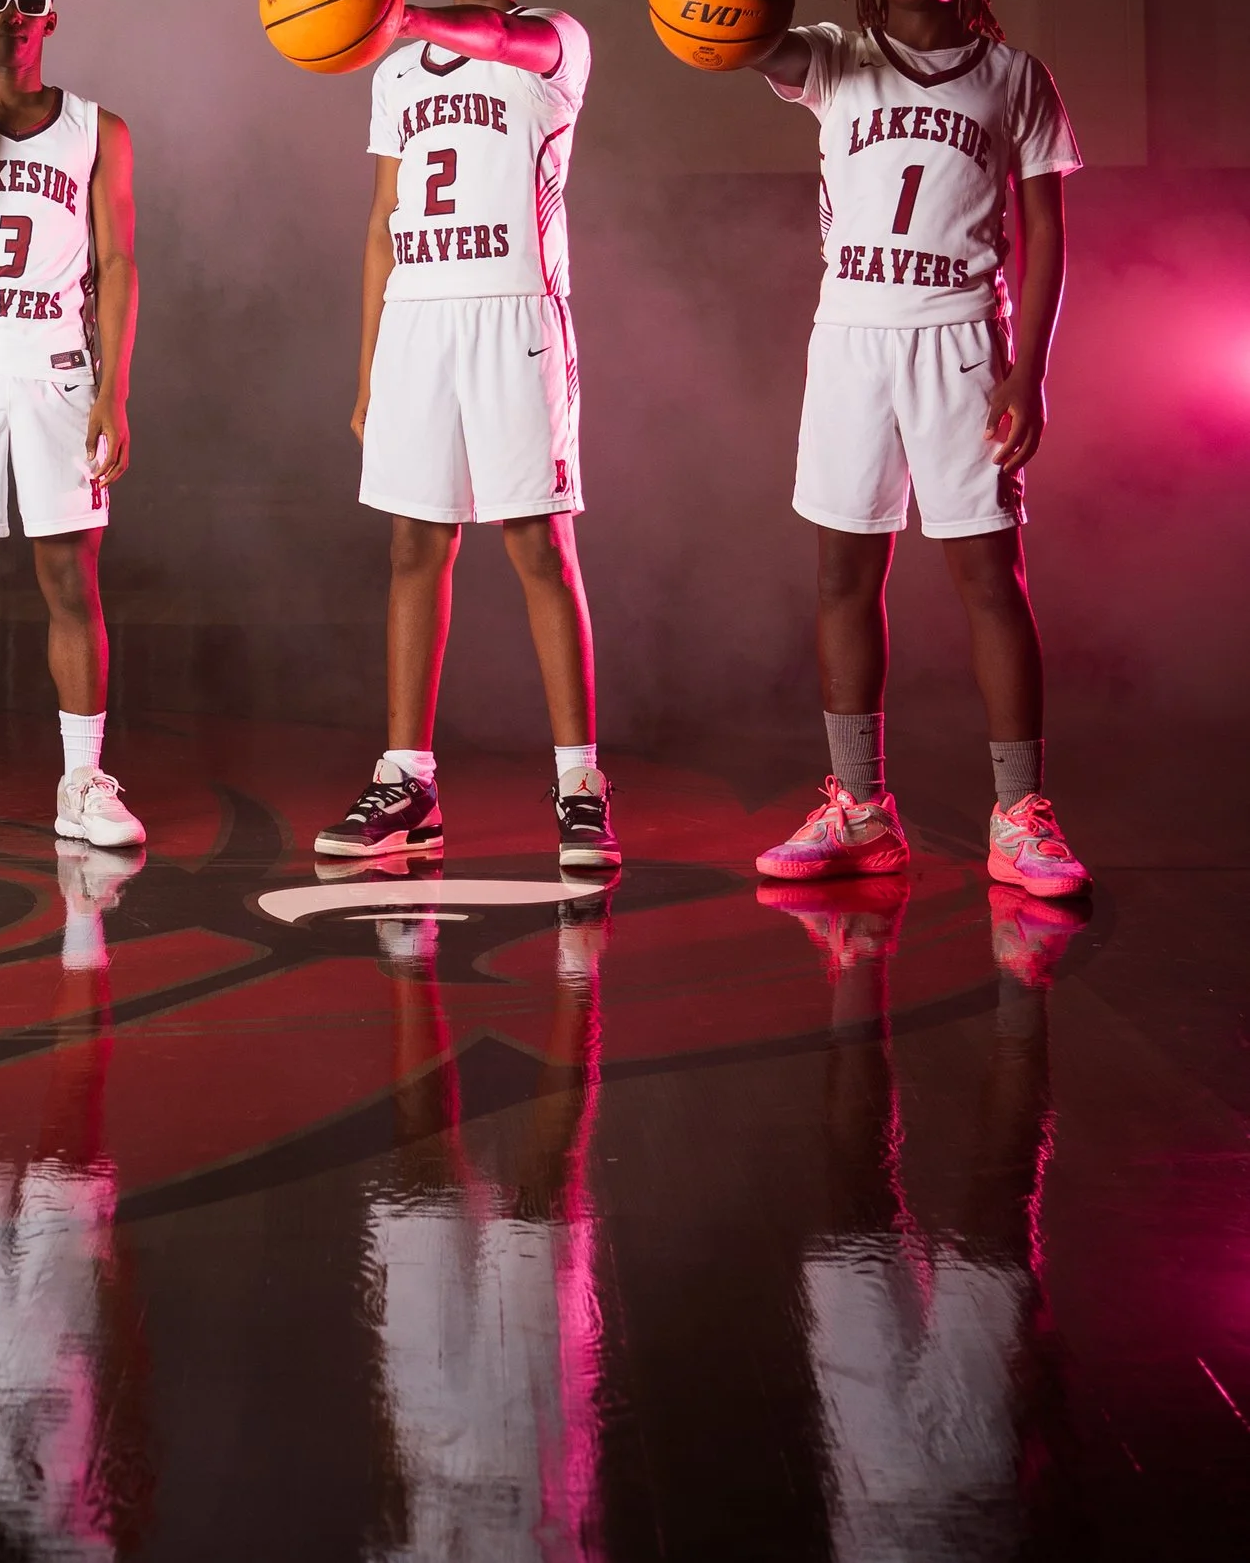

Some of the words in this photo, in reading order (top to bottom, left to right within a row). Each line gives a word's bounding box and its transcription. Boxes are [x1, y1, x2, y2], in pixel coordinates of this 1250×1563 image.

[681, 0, 742, 27] EVO
[849, 106, 992, 173] LAKESIDE
[424, 148, 457, 217] 2
[891, 164, 925, 235] 1
[837, 245, 969, 288] BEAVERS
